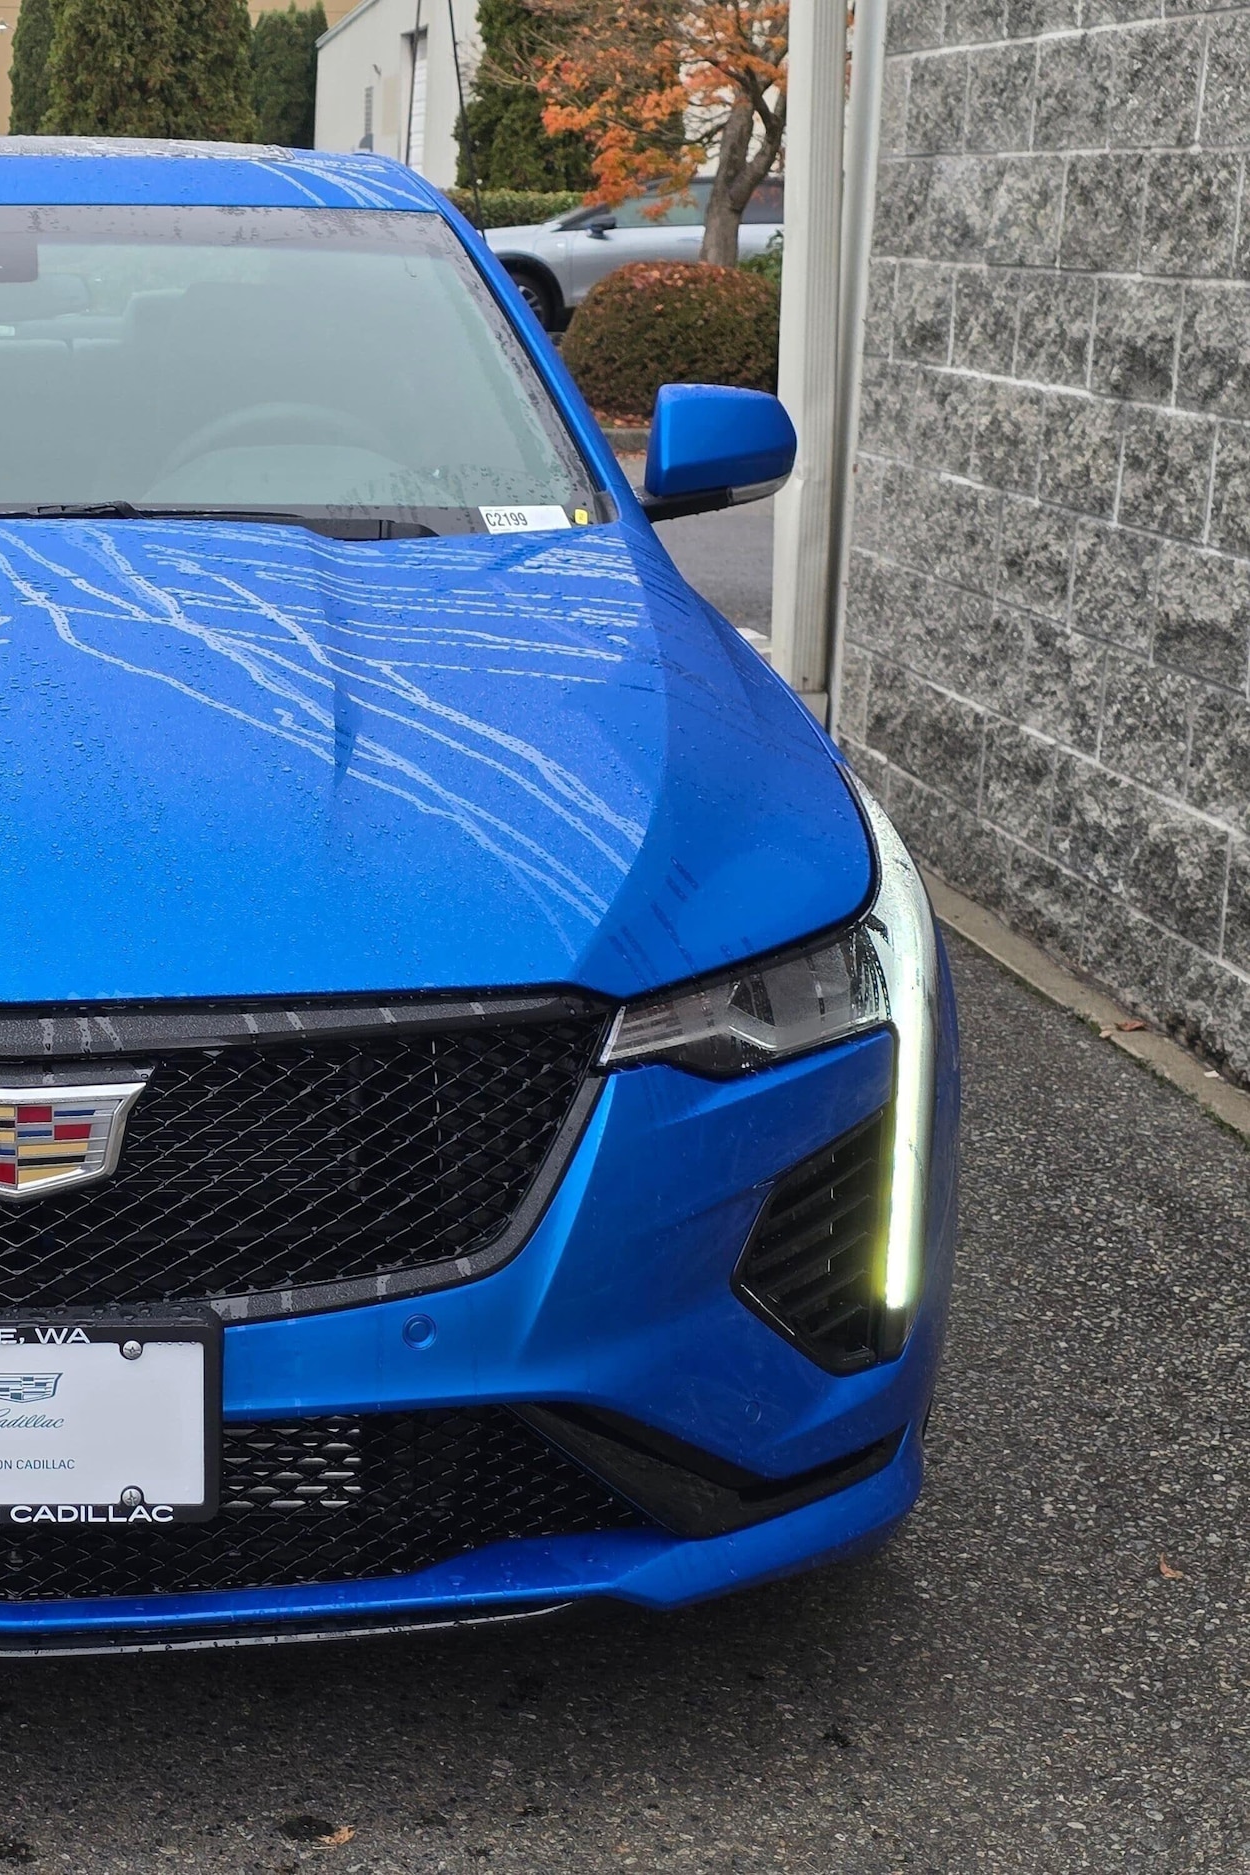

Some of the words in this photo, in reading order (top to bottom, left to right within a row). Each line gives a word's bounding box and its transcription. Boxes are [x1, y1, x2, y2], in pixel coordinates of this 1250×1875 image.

[485, 512, 528, 527] C2199
[34, 1327, 91, 1345] WA
[16, 1459, 75, 1470] CADILLAC
[10, 1505, 174, 1523] CADILLAC
